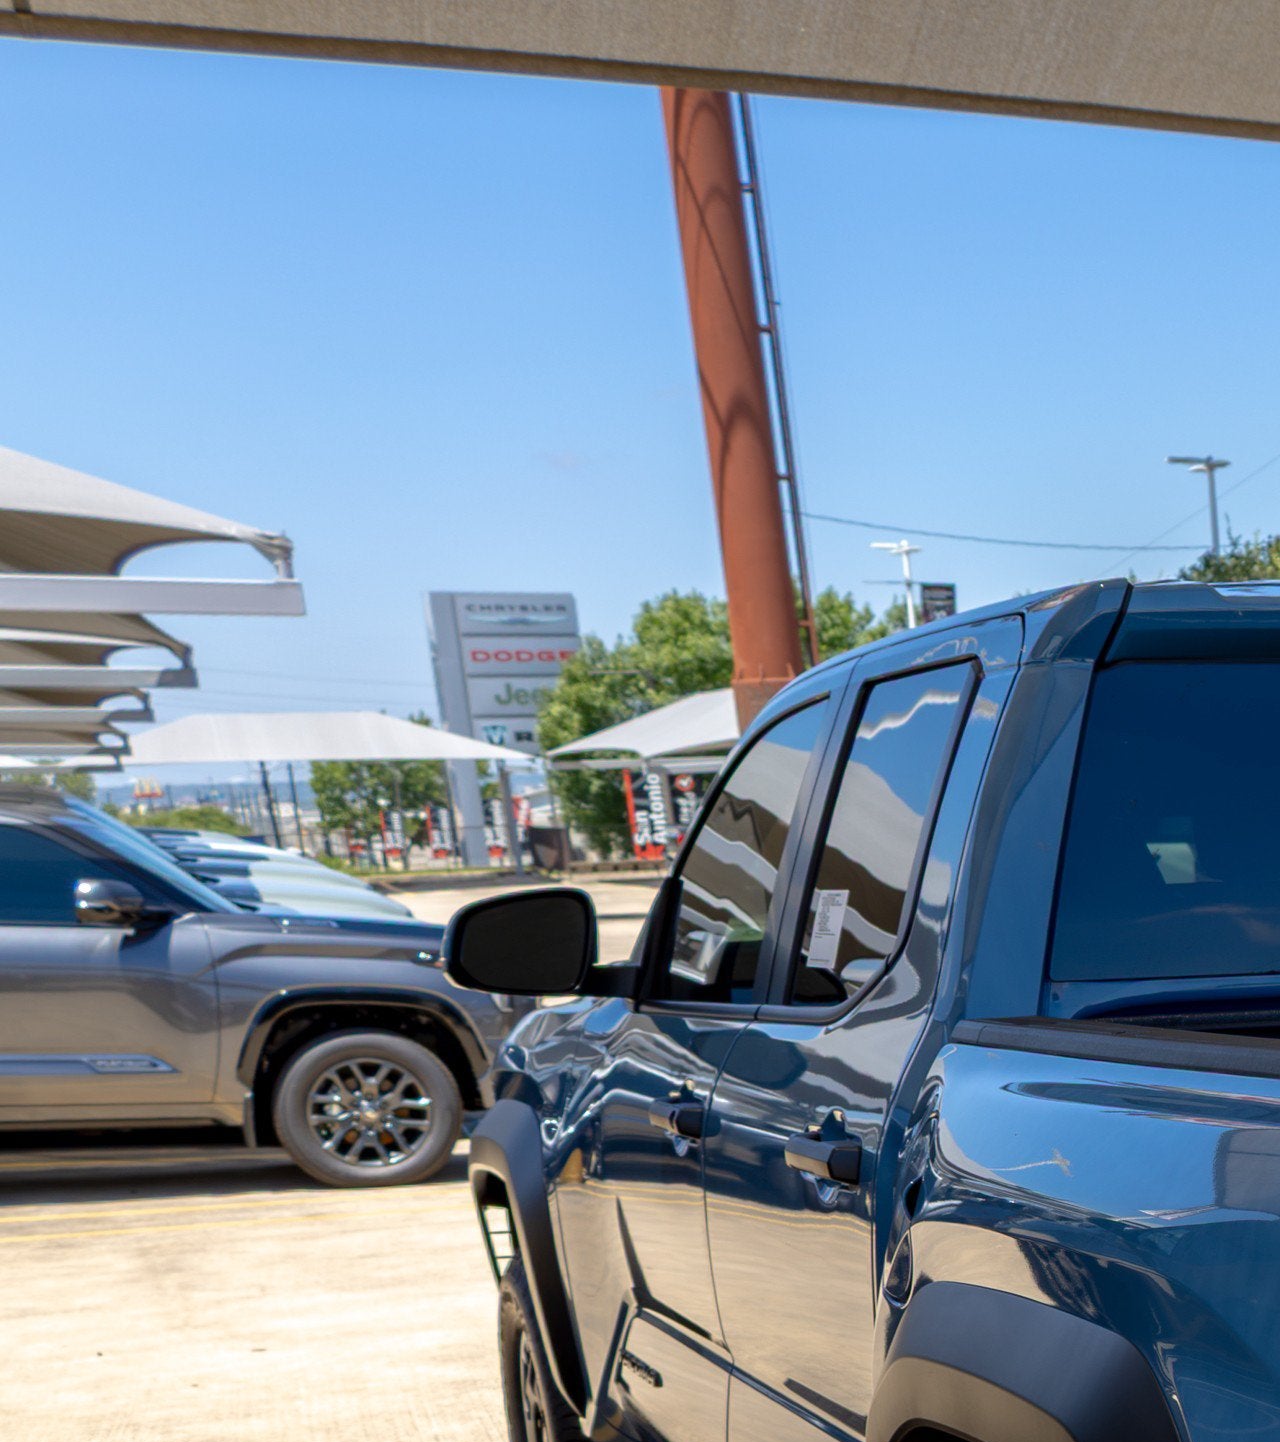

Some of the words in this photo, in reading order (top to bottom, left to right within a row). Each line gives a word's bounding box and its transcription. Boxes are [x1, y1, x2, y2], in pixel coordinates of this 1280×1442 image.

[465, 603, 567, 613] CHRYSLER
[643, 772, 668, 845] Antonio
[633, 809, 650, 847] San
